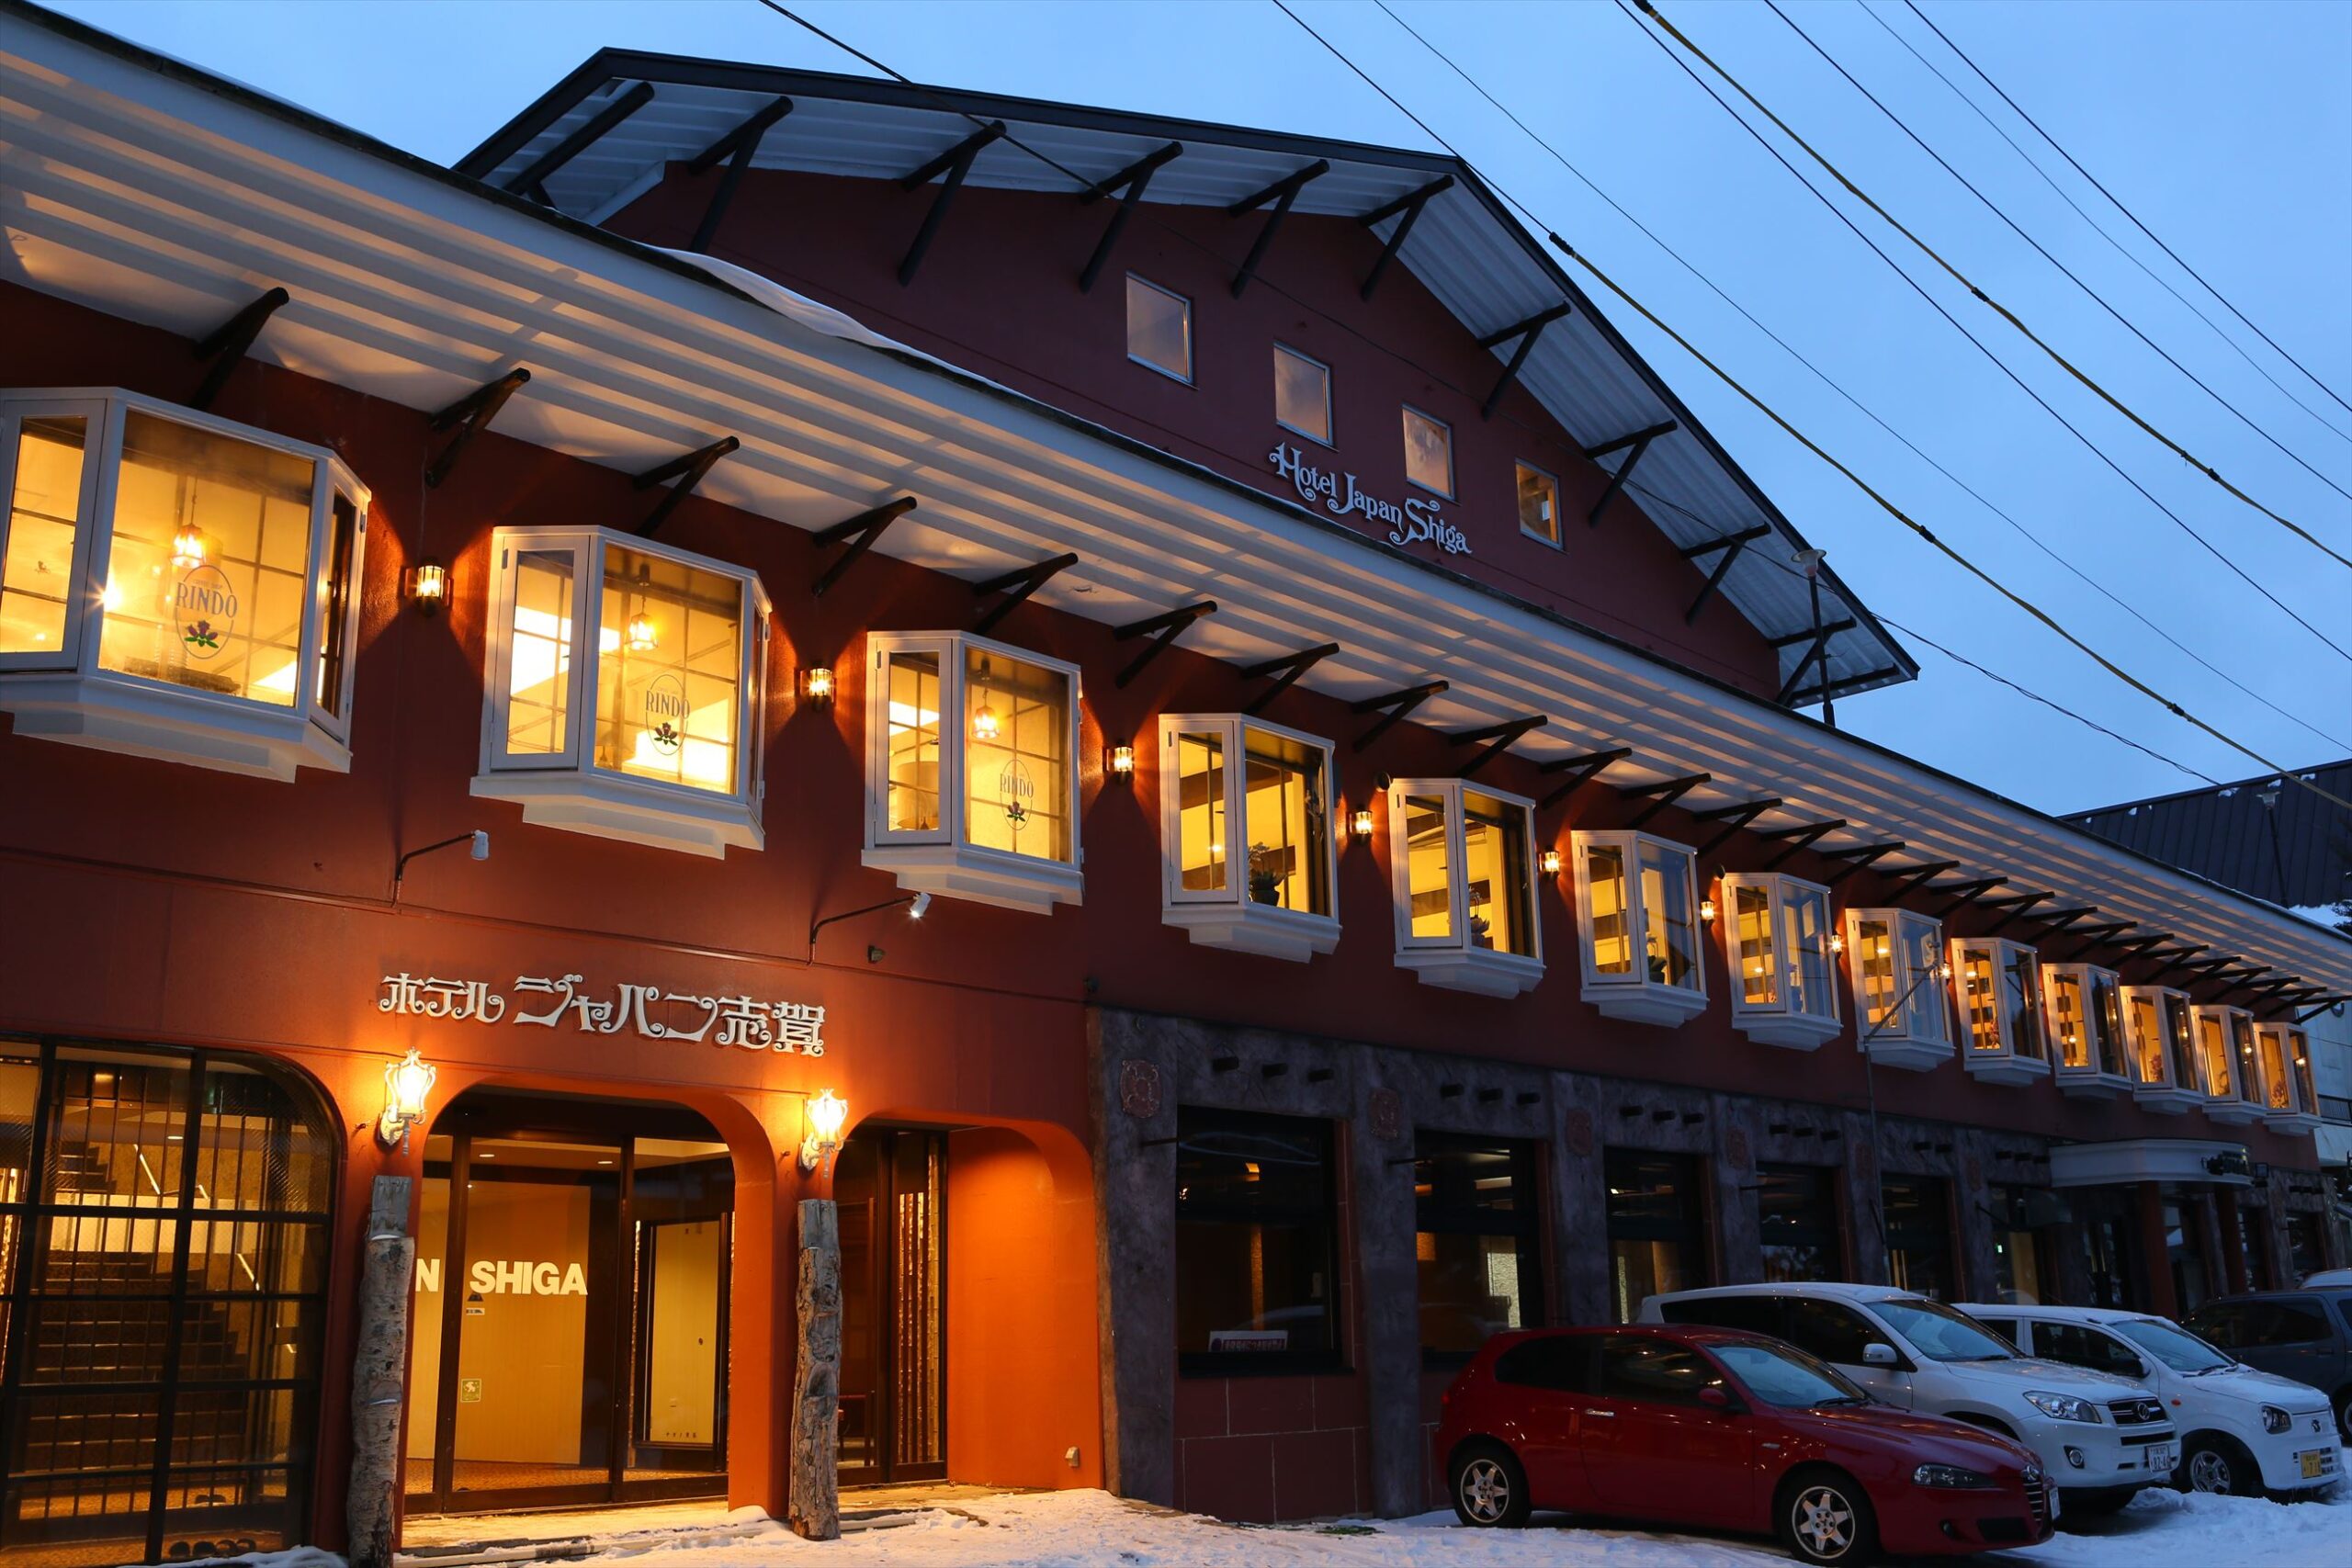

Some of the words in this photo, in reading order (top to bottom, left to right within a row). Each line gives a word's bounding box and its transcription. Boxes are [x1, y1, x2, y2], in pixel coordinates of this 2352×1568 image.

[1269, 442, 1338, 502] Hotel
[1327, 471, 1404, 533] Japan
[1389, 498, 1472, 555] Shiga
[175, 581, 237, 618] RINDO
[646, 690, 690, 720] RINDO
[1000, 773, 1034, 798] RINDO
[469, 1260, 589, 1296] SHIGA
